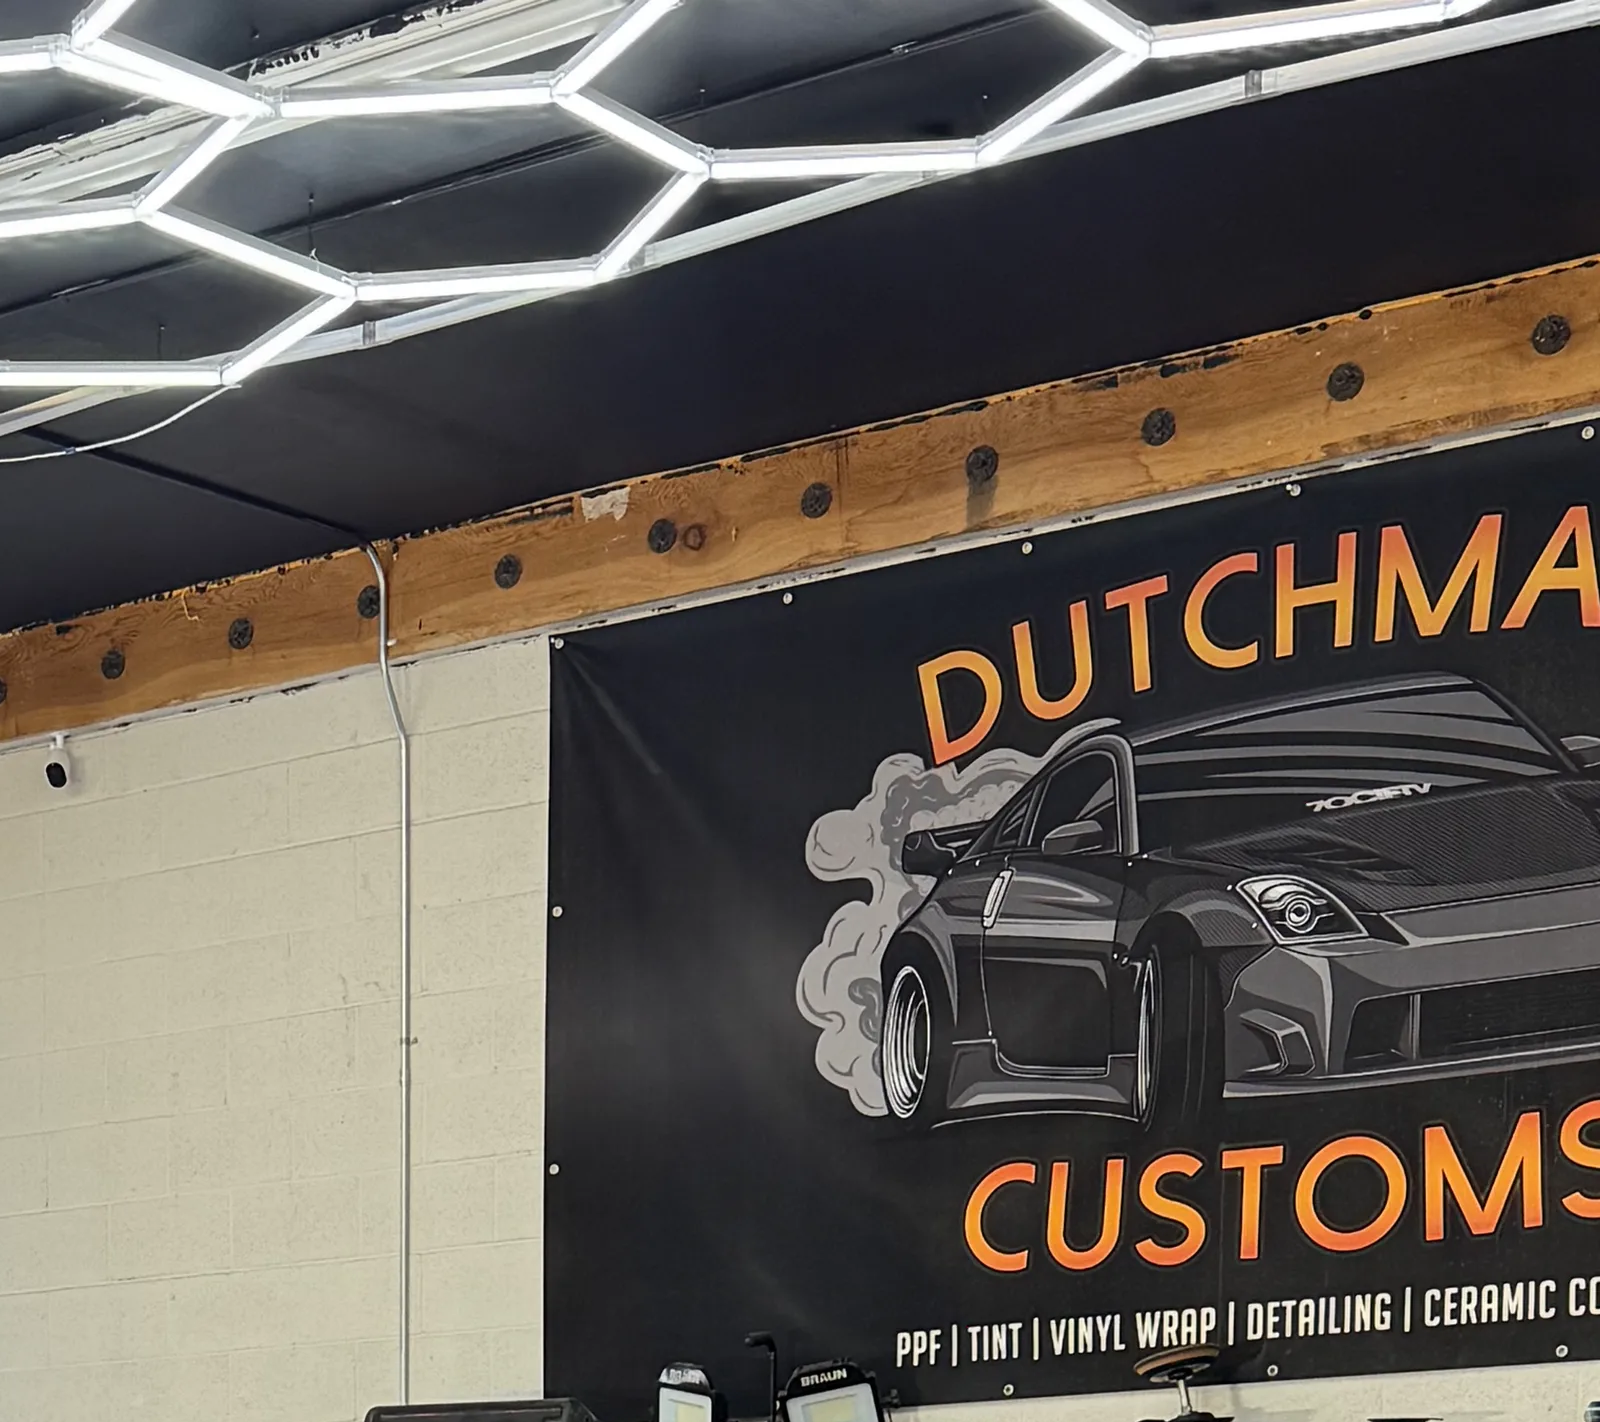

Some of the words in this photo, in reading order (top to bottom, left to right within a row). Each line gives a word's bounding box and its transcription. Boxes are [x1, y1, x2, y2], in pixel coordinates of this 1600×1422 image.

[916, 505, 1600, 764] DUTCHMA
[896, 1328, 941, 1367] PPF
[968, 1322, 1022, 1362] TINT
[1050, 1313, 1126, 1356] VINYL
[1136, 1307, 1216, 1349] WRAP
[1246, 1292, 1392, 1341] DETAILING
[1424, 1279, 1556, 1327] CERAMIC
[800, 1368, 848, 1388] BRAUN
